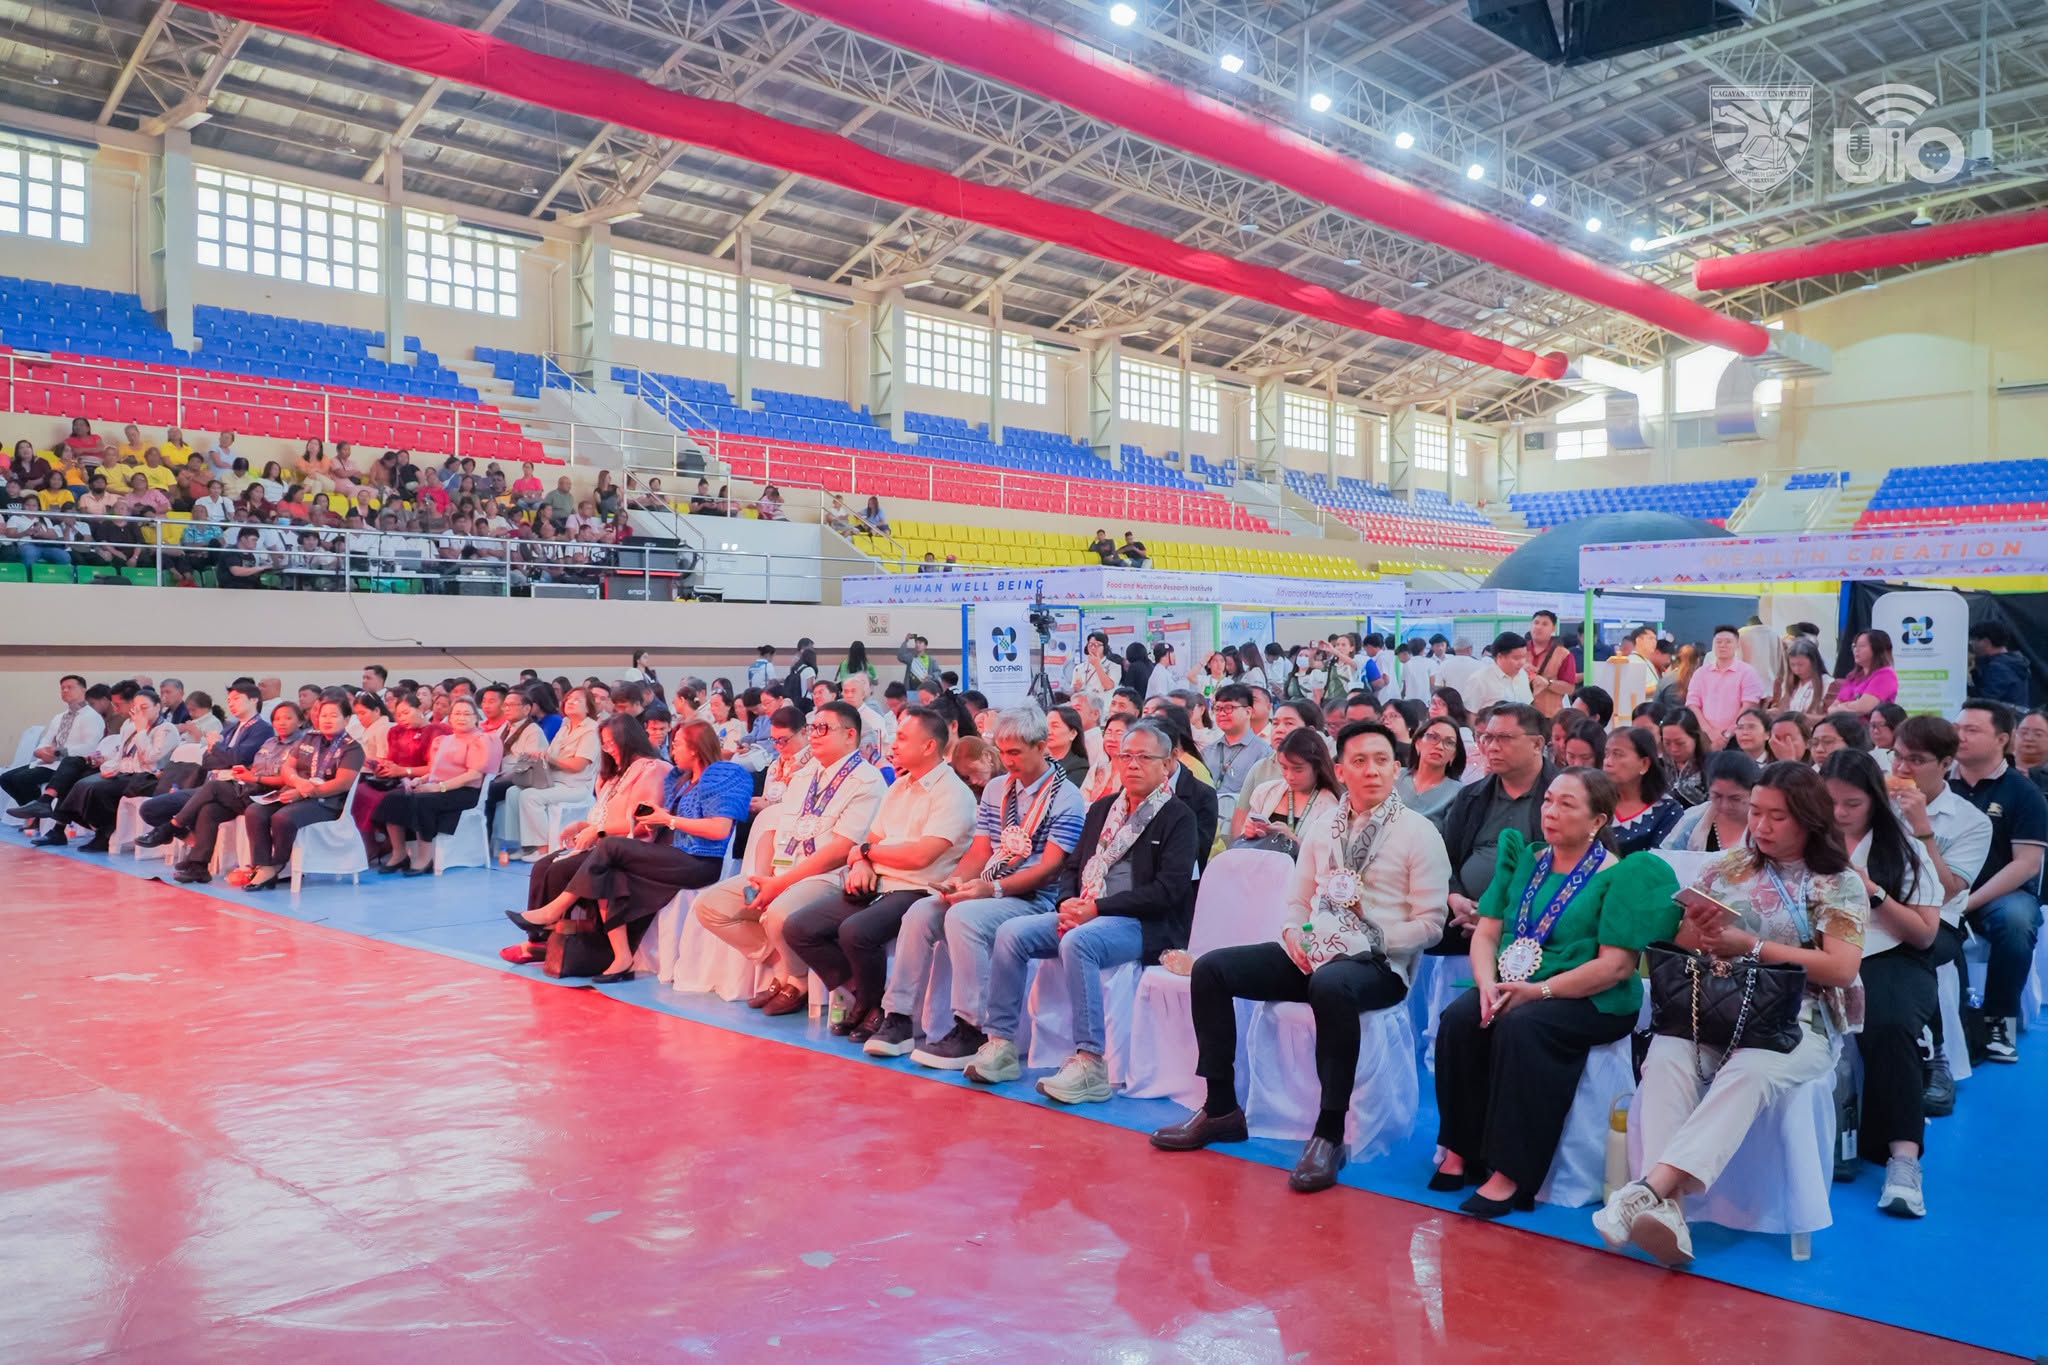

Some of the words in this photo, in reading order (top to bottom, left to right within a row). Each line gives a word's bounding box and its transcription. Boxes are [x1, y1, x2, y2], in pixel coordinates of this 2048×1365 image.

[1704, 549, 1827, 567] WEALTH
[1847, 540, 2023, 562] CREATION
[894, 583, 943, 594] HUMAN
[951, 582, 989, 592] WELL
[997, 579, 1044, 591] BEING
[1106, 581, 1122, 589] Food
[1123, 582, 1135, 590] and
[1136, 583, 1162, 591] Nutrition
[1163, 583, 1188, 591] Research
[1189, 584, 1213, 592] Institute
[1276, 588, 1308, 598] Advanced
[1308, 590, 1353, 601] Manufacturing
[1354, 591, 1374, 600] Center
[1409, 598, 1432, 607] ITY
[869, 615, 879, 624] NO
[989, 665, 1023, 673] DOST-FNRI
